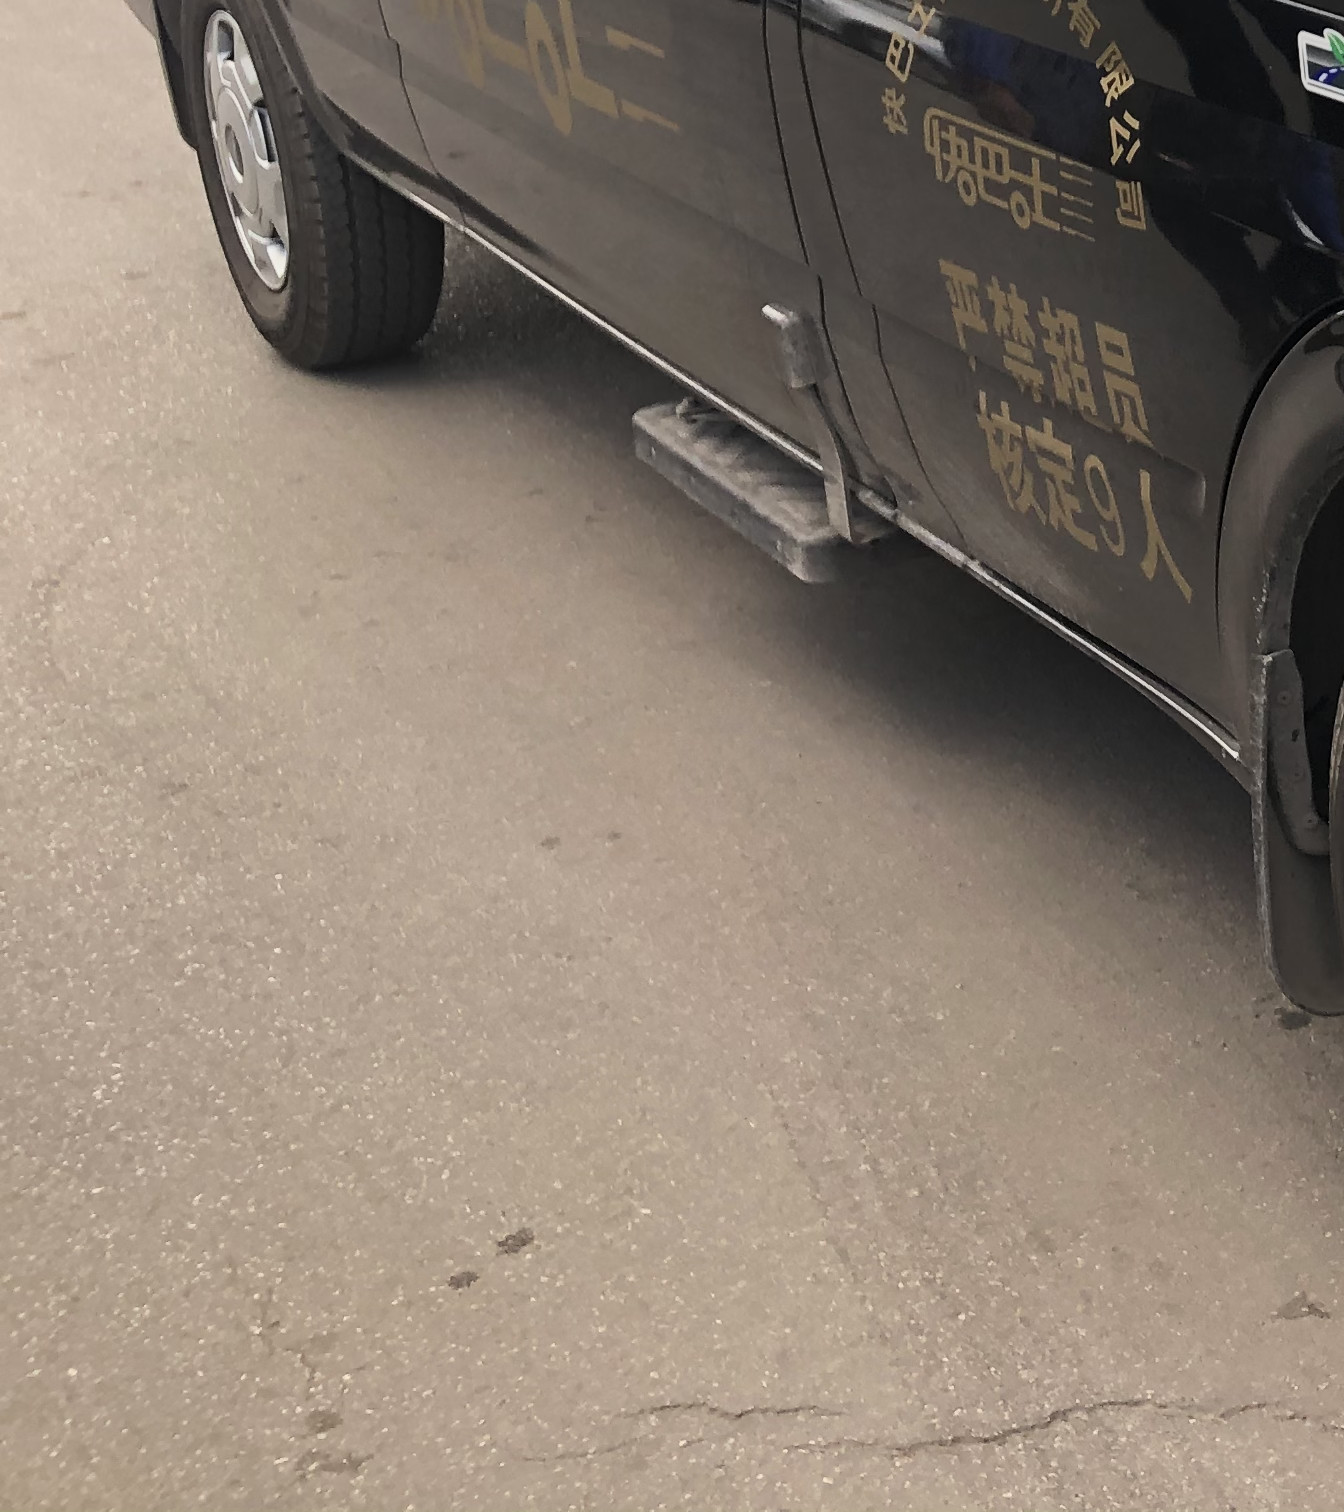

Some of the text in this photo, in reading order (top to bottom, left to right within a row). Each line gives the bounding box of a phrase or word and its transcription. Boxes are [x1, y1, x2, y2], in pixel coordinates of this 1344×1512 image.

[938, 258, 1154, 449] 严禁超员
[976, 389, 1193, 604] 核定9人
